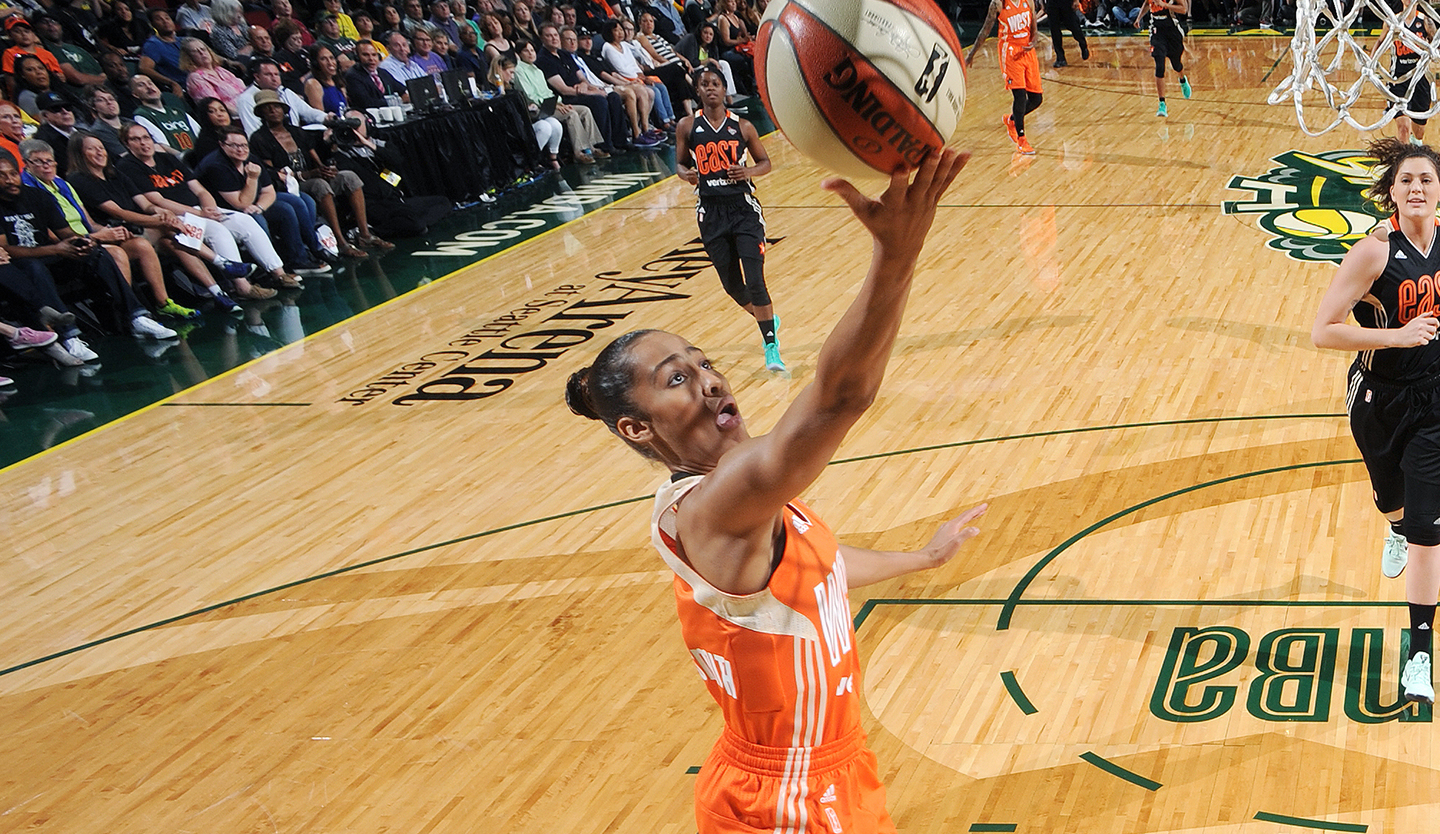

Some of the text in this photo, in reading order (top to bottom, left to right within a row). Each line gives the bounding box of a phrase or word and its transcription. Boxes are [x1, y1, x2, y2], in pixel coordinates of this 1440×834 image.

[823, 56, 937, 168] PALDING
[173, 131, 194, 150] 10
[706, 178, 737, 187] verizon
[411, 171, 662, 256] WNBA.COM
[449, 297, 569, 348] Seattle
[336, 350, 471, 407] Center
